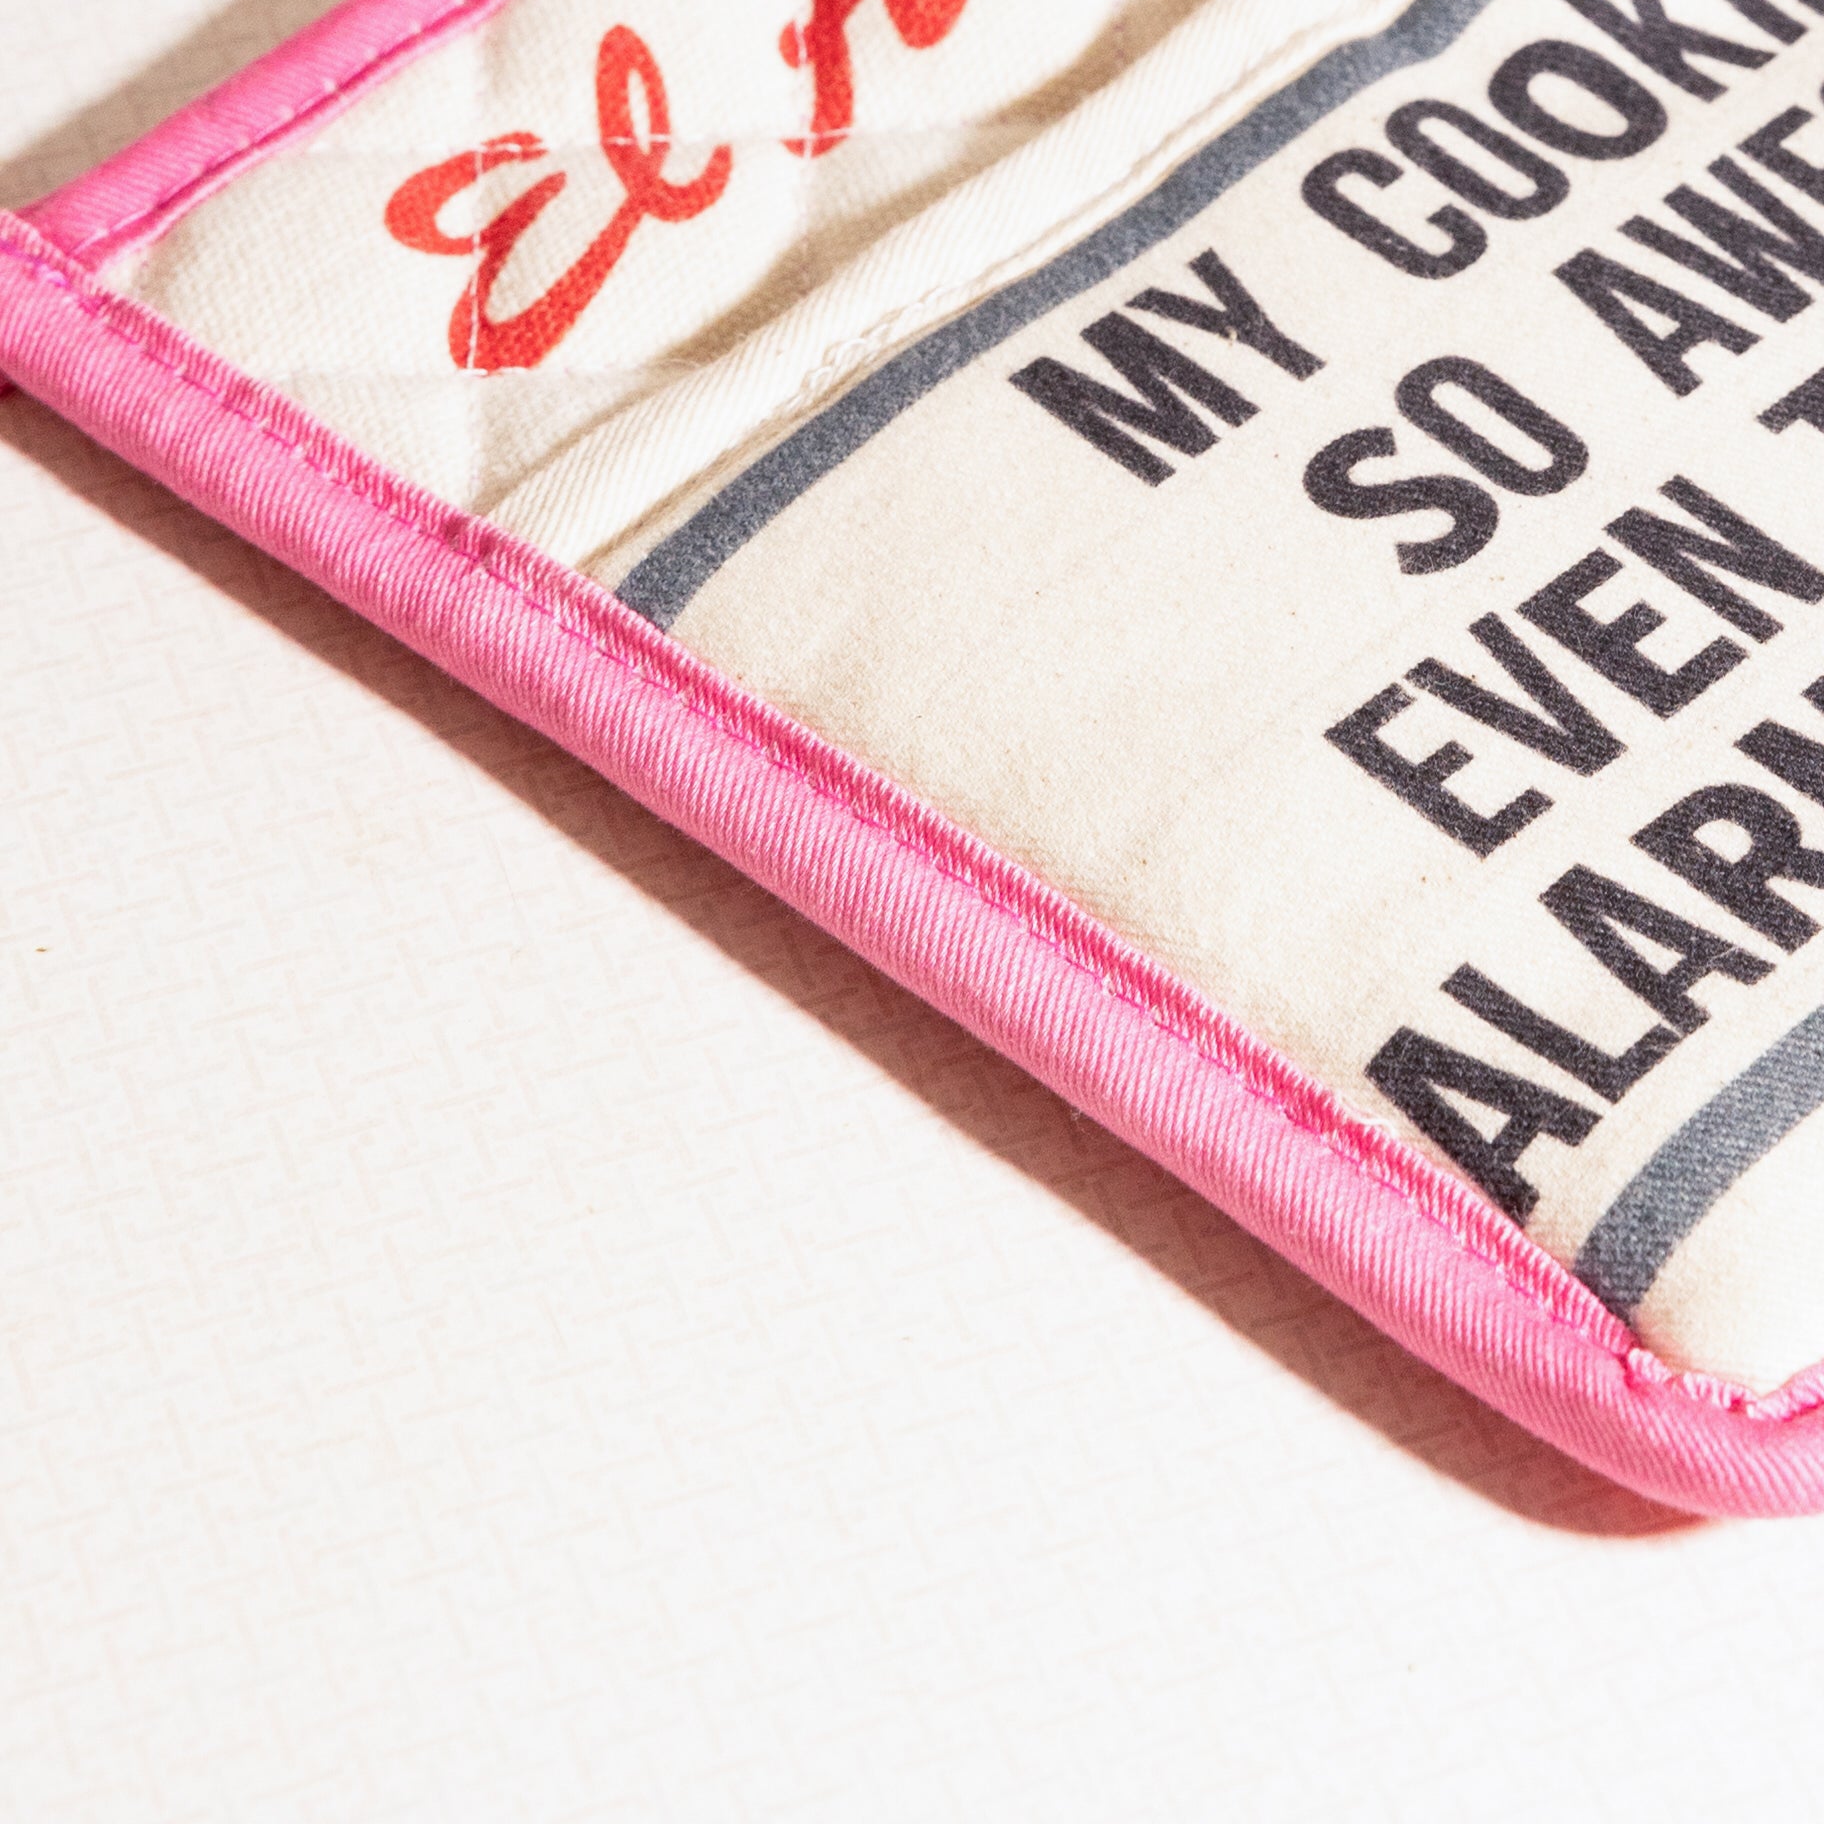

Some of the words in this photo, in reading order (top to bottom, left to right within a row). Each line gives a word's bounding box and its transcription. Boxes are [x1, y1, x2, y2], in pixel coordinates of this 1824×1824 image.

[384, 24, 731, 375] El
[1009, 249, 1324, 487] MY
[1302, 356, 1589, 577] SO
